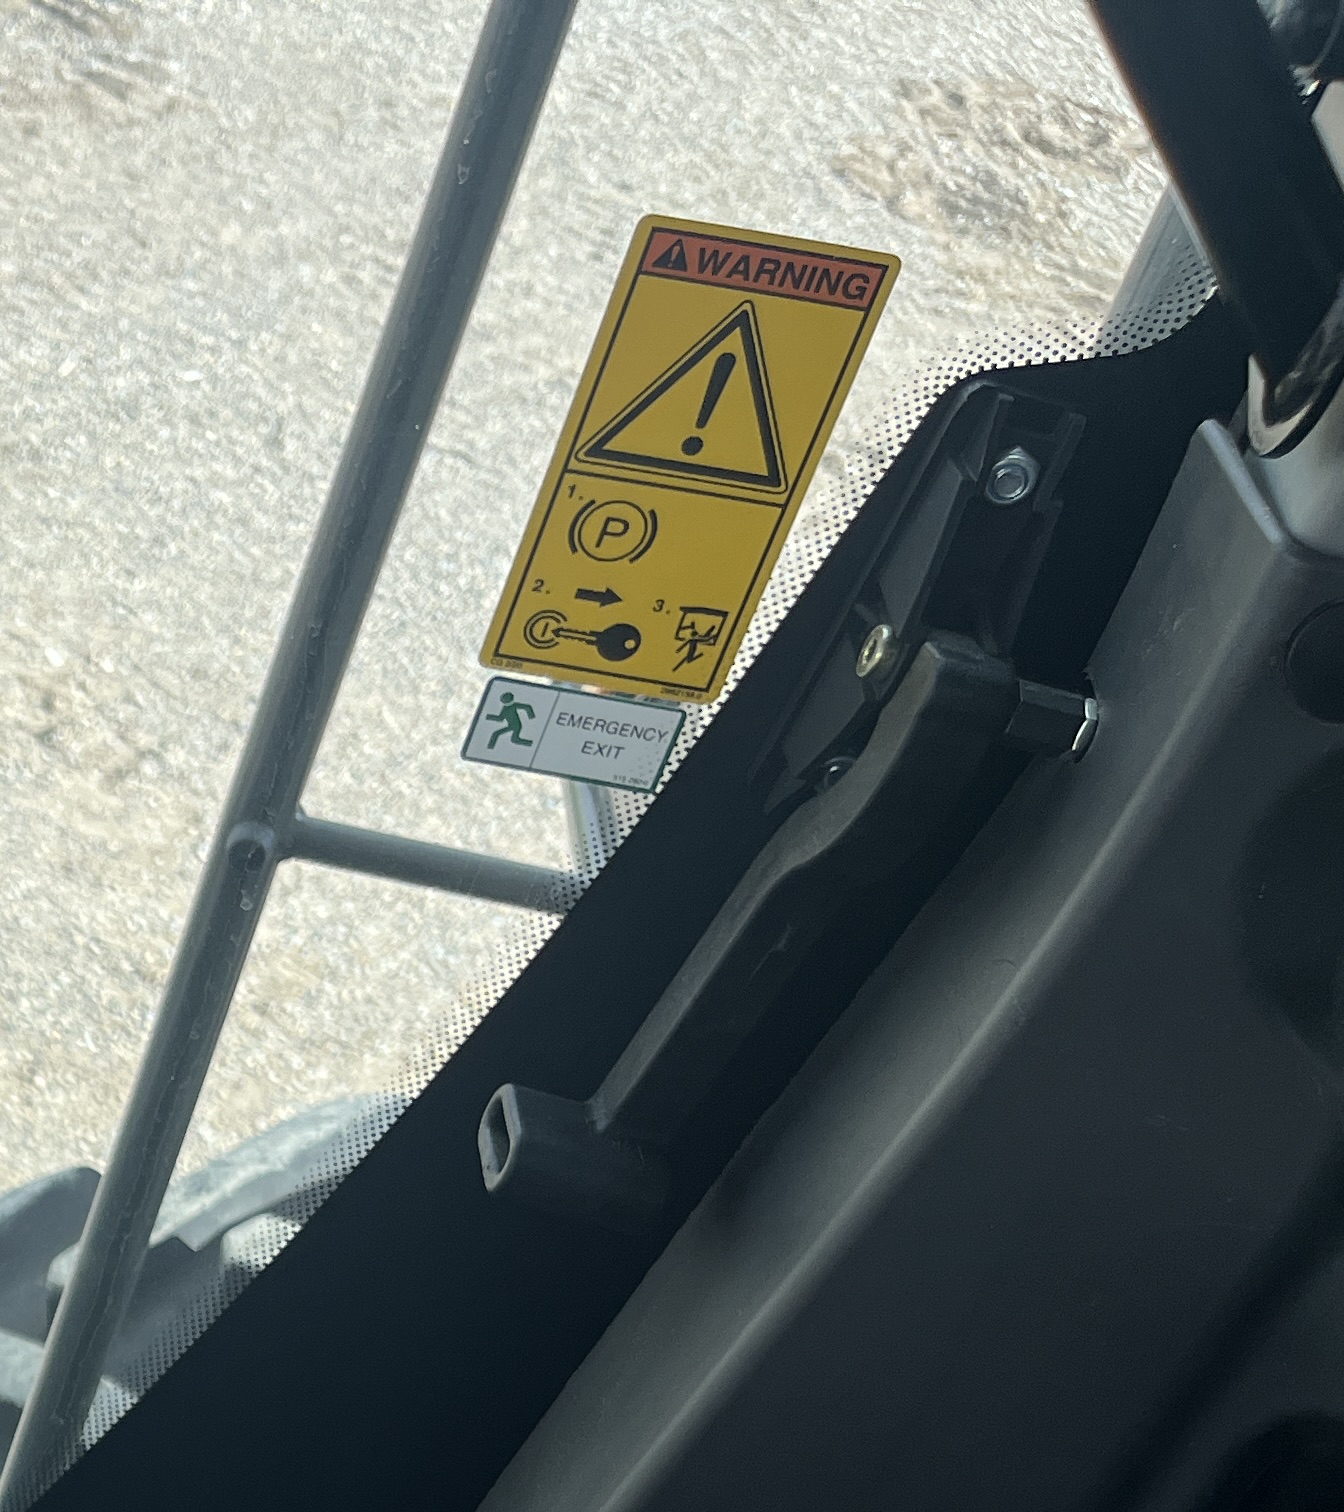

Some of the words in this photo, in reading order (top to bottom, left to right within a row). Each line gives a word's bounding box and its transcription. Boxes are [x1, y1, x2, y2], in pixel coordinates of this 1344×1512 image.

[695, 247, 872, 302] WARNING
[595, 516, 630, 548] P
[556, 712, 669, 744] EMERGENCY
[581, 741, 625, 760] EXIT
